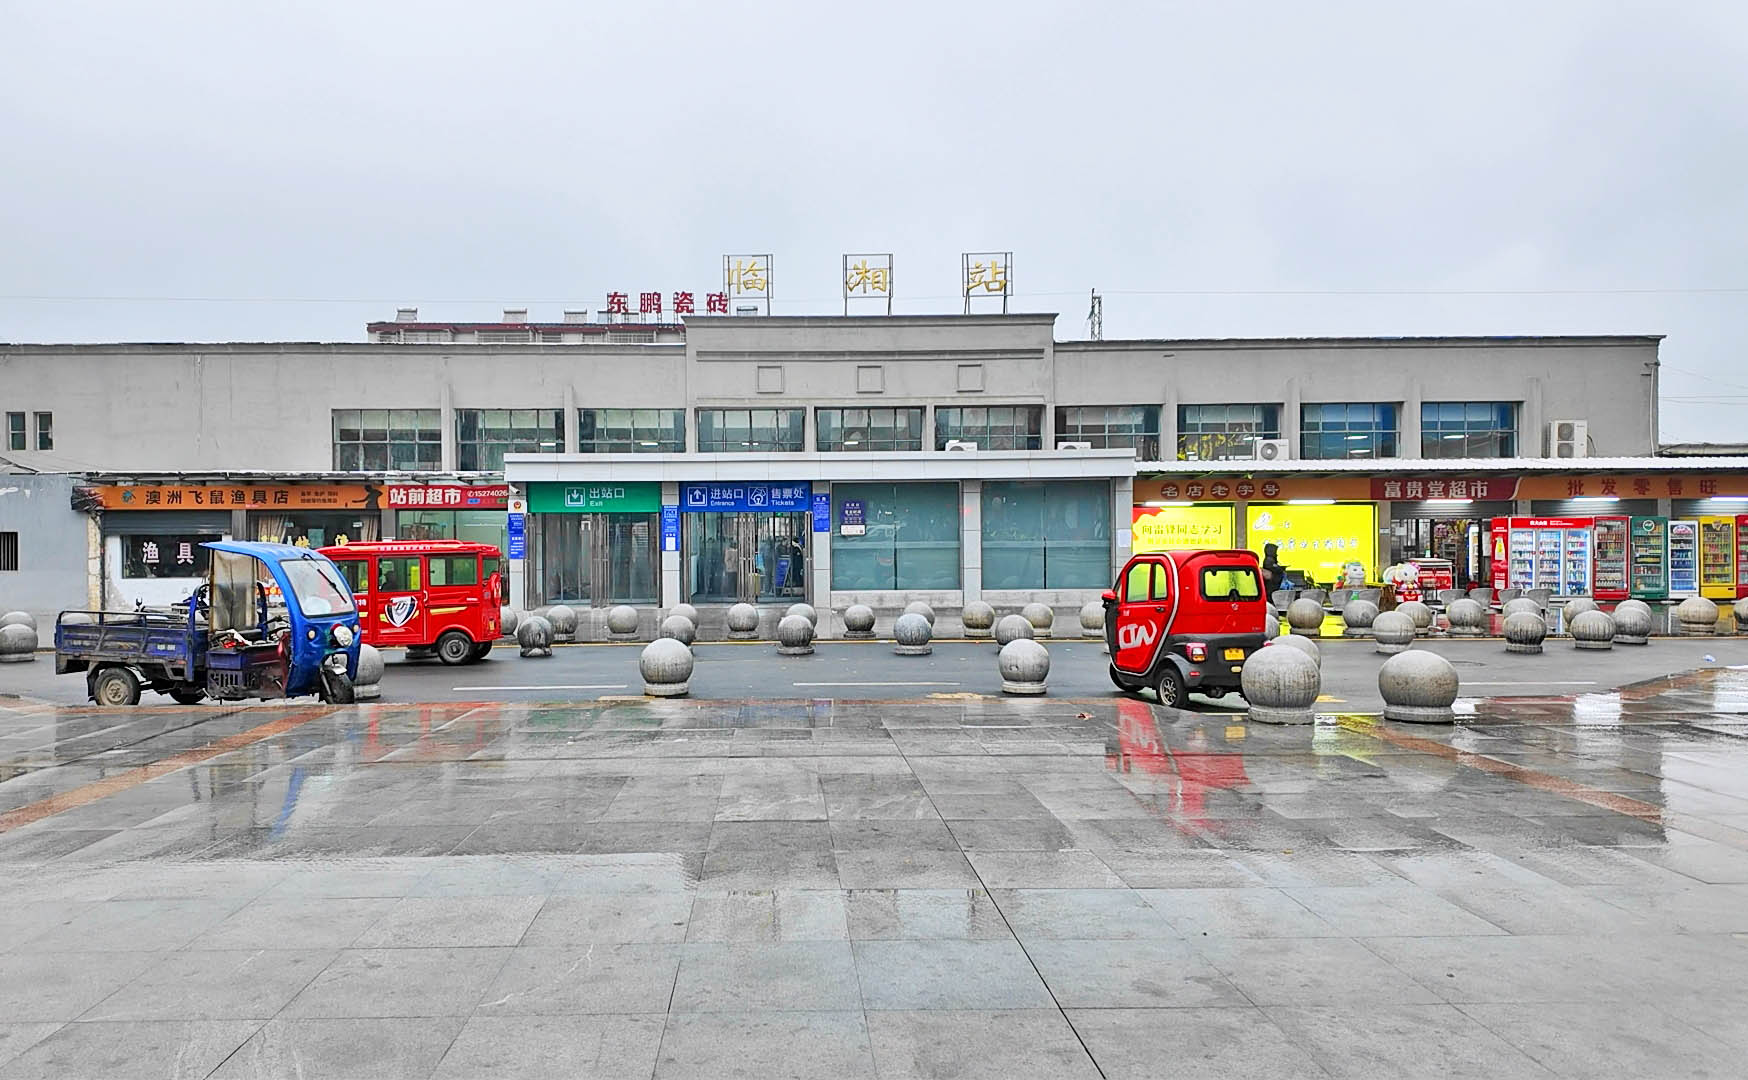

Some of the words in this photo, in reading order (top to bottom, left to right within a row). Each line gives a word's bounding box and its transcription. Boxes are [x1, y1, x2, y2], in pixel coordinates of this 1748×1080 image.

[728, 259, 1007, 294] 临湘站
[607, 292, 729, 314] 东鹏瓷砖
[589, 487, 625, 499] 出站口
[710, 487, 744, 500] 进站口
[771, 487, 804, 500] 售票处
[1161, 484, 1279, 498] 名店老字号
[1384, 481, 1489, 498] 富贵堂超市
[1567, 479, 1717, 496] 批发零售旺
[145, 490, 289, 505] 澳洲飞鼠渔具店
[389, 488, 462, 505] 站前超市
[142, 541, 194, 565] 渔具
